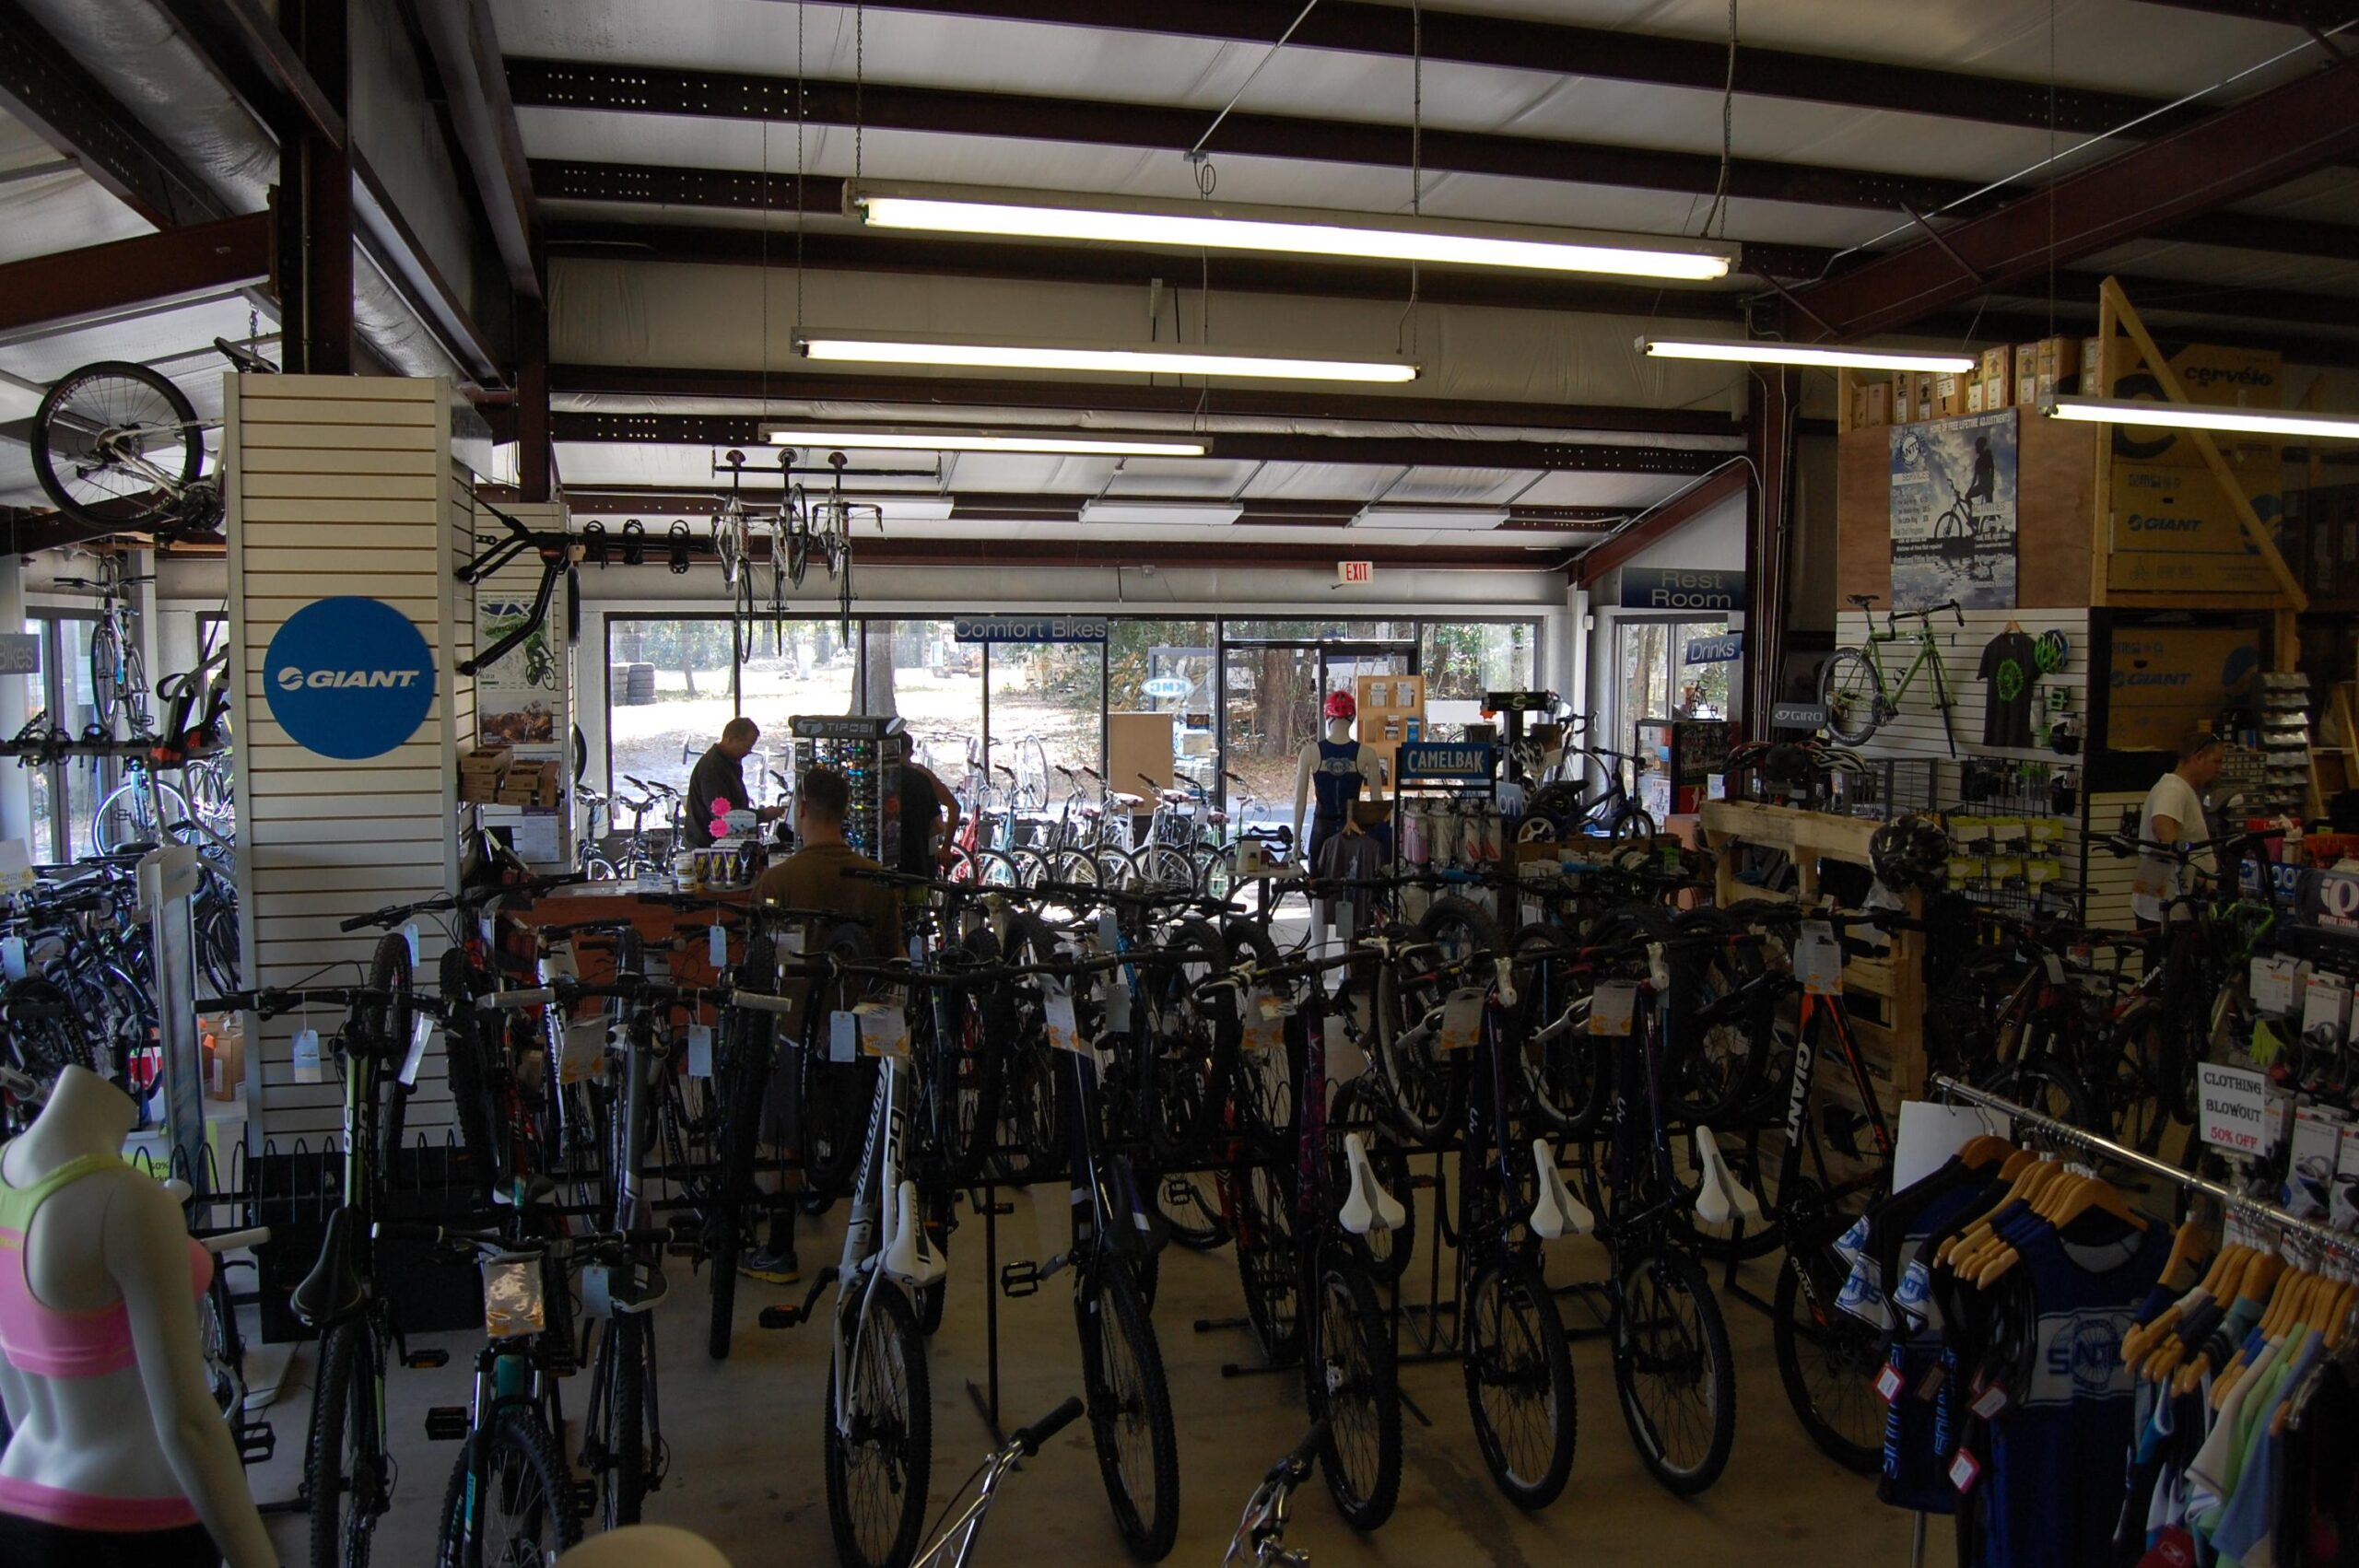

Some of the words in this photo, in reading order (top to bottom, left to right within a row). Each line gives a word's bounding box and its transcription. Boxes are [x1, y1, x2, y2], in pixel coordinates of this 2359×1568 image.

[2144, 518, 2203, 532] GIANT
[1345, 563, 1368, 581] EXIT
[1661, 570, 1723, 590] Rest
[1651, 589, 1732, 609] Room
[955, 619, 1044, 638] Comfort
[1051, 619, 1107, 638] Bikes
[1690, 639, 1735, 661] Drinks
[306, 670, 420, 688] GIANT
[2128, 673, 2191, 686] GIANT
[1790, 709, 1824, 722] GIRO
[827, 722, 874, 733] TIFOSI
[1407, 749, 1485, 773] CAMELBAK
[2204, 1071, 2262, 1095] CLOTHING
[1786, 1042, 1812, 1148] GIANT
[2206, 1098, 2261, 1123] BLOWOUT
[855, 1071, 885, 1203] CANNONDALE
[2210, 1126, 2234, 1143] 50%
[2236, 1133, 2258, 1149] OFF
